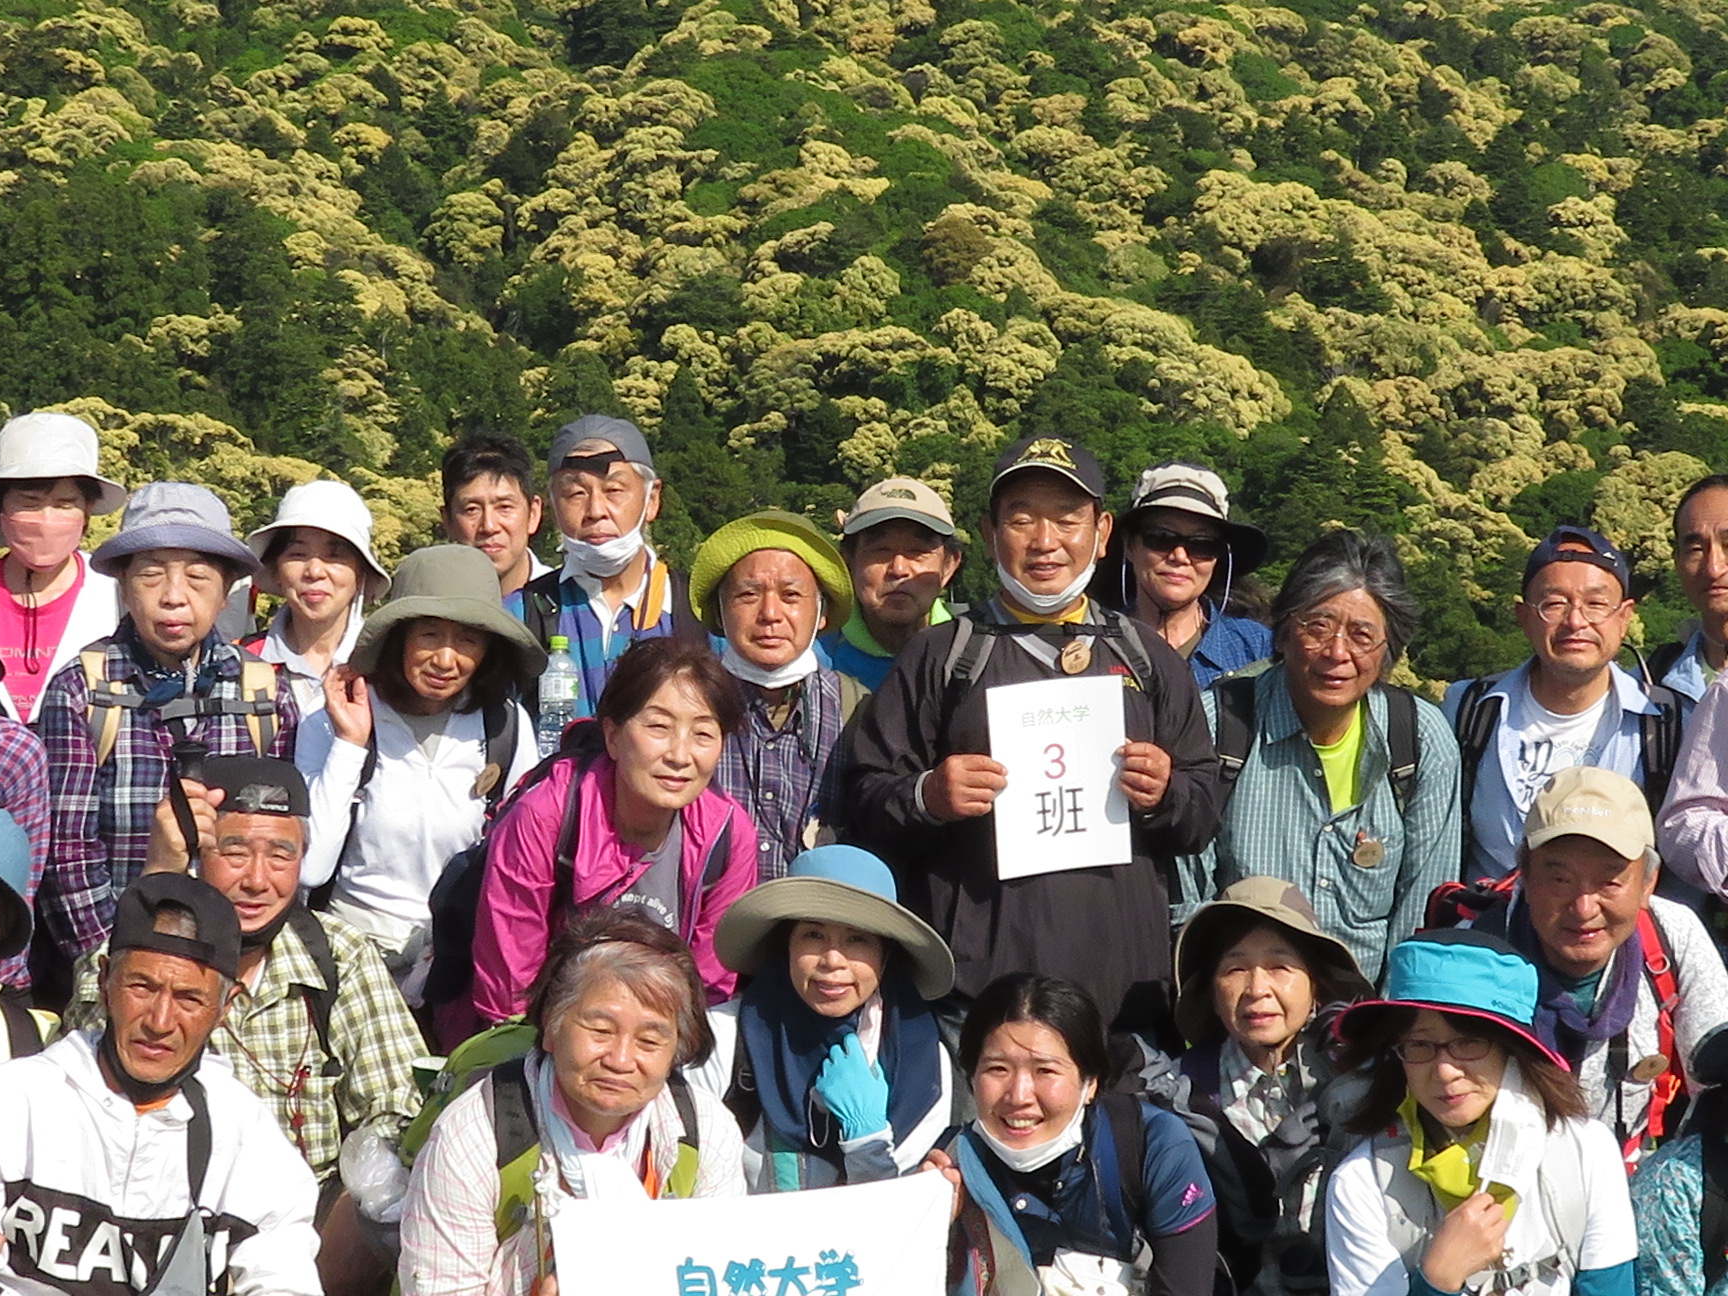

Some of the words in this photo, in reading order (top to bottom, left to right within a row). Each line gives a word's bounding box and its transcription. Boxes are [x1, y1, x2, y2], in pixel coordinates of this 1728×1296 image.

[1022, 705, 1091, 727] 自然大学
[1043, 743, 1066, 779] 3
[1035, 786, 1087, 837] 班
